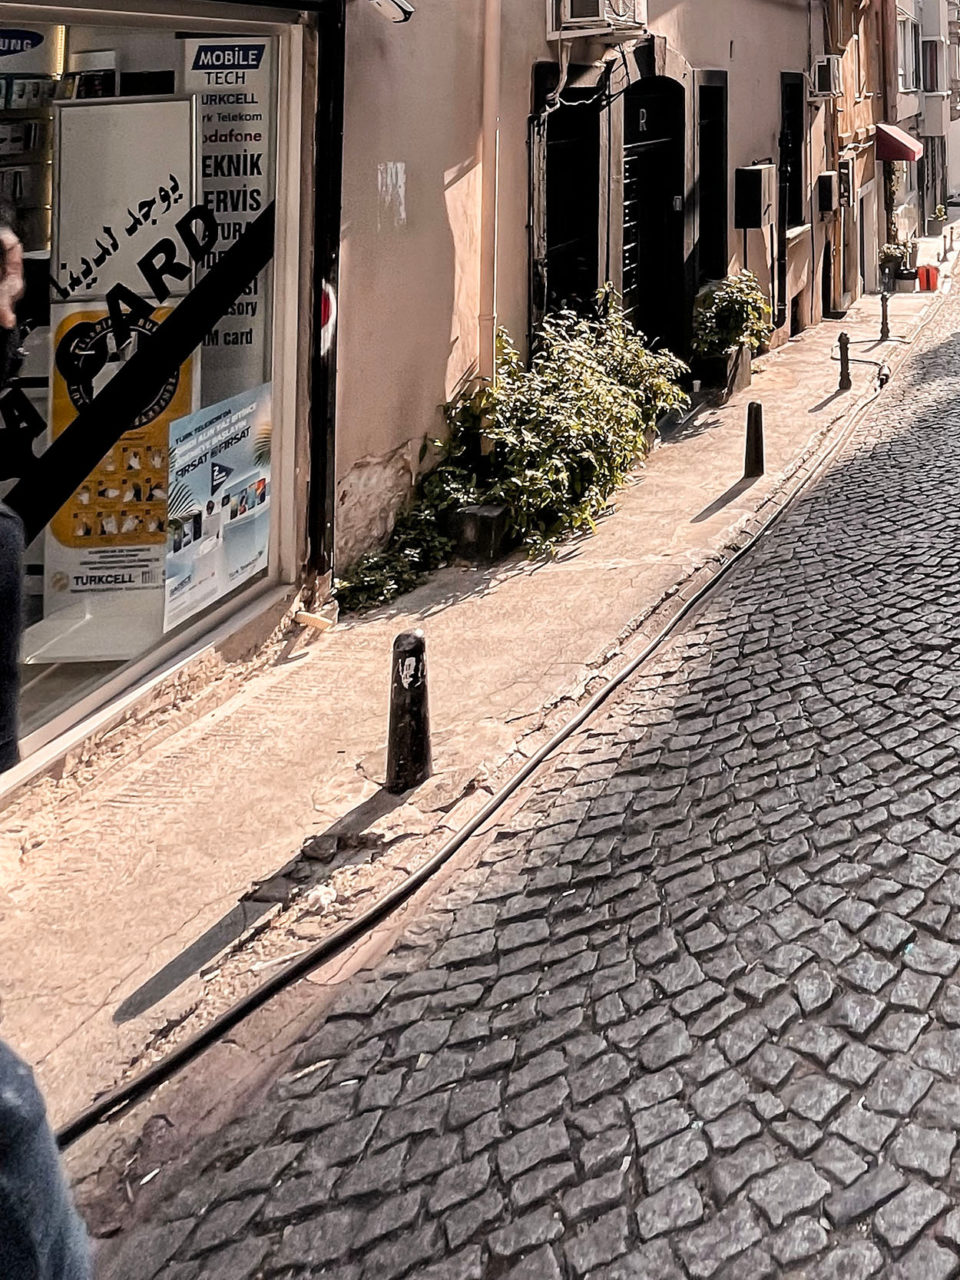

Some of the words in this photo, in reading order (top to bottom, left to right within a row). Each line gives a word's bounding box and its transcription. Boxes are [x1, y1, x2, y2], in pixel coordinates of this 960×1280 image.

[199, 47, 258, 66] MOBİLE
[204, 71, 246, 85] TECH
[201, 93, 258, 105] URKCELL
[217, 111, 262, 122] Telekom
[202, 128, 262, 143] odafone
[202, 149, 263, 178] EKNİK
[203, 184, 261, 213] ERVİS
[224, 328, 252, 345] card
[74, 573, 135, 586] TURKCELL
